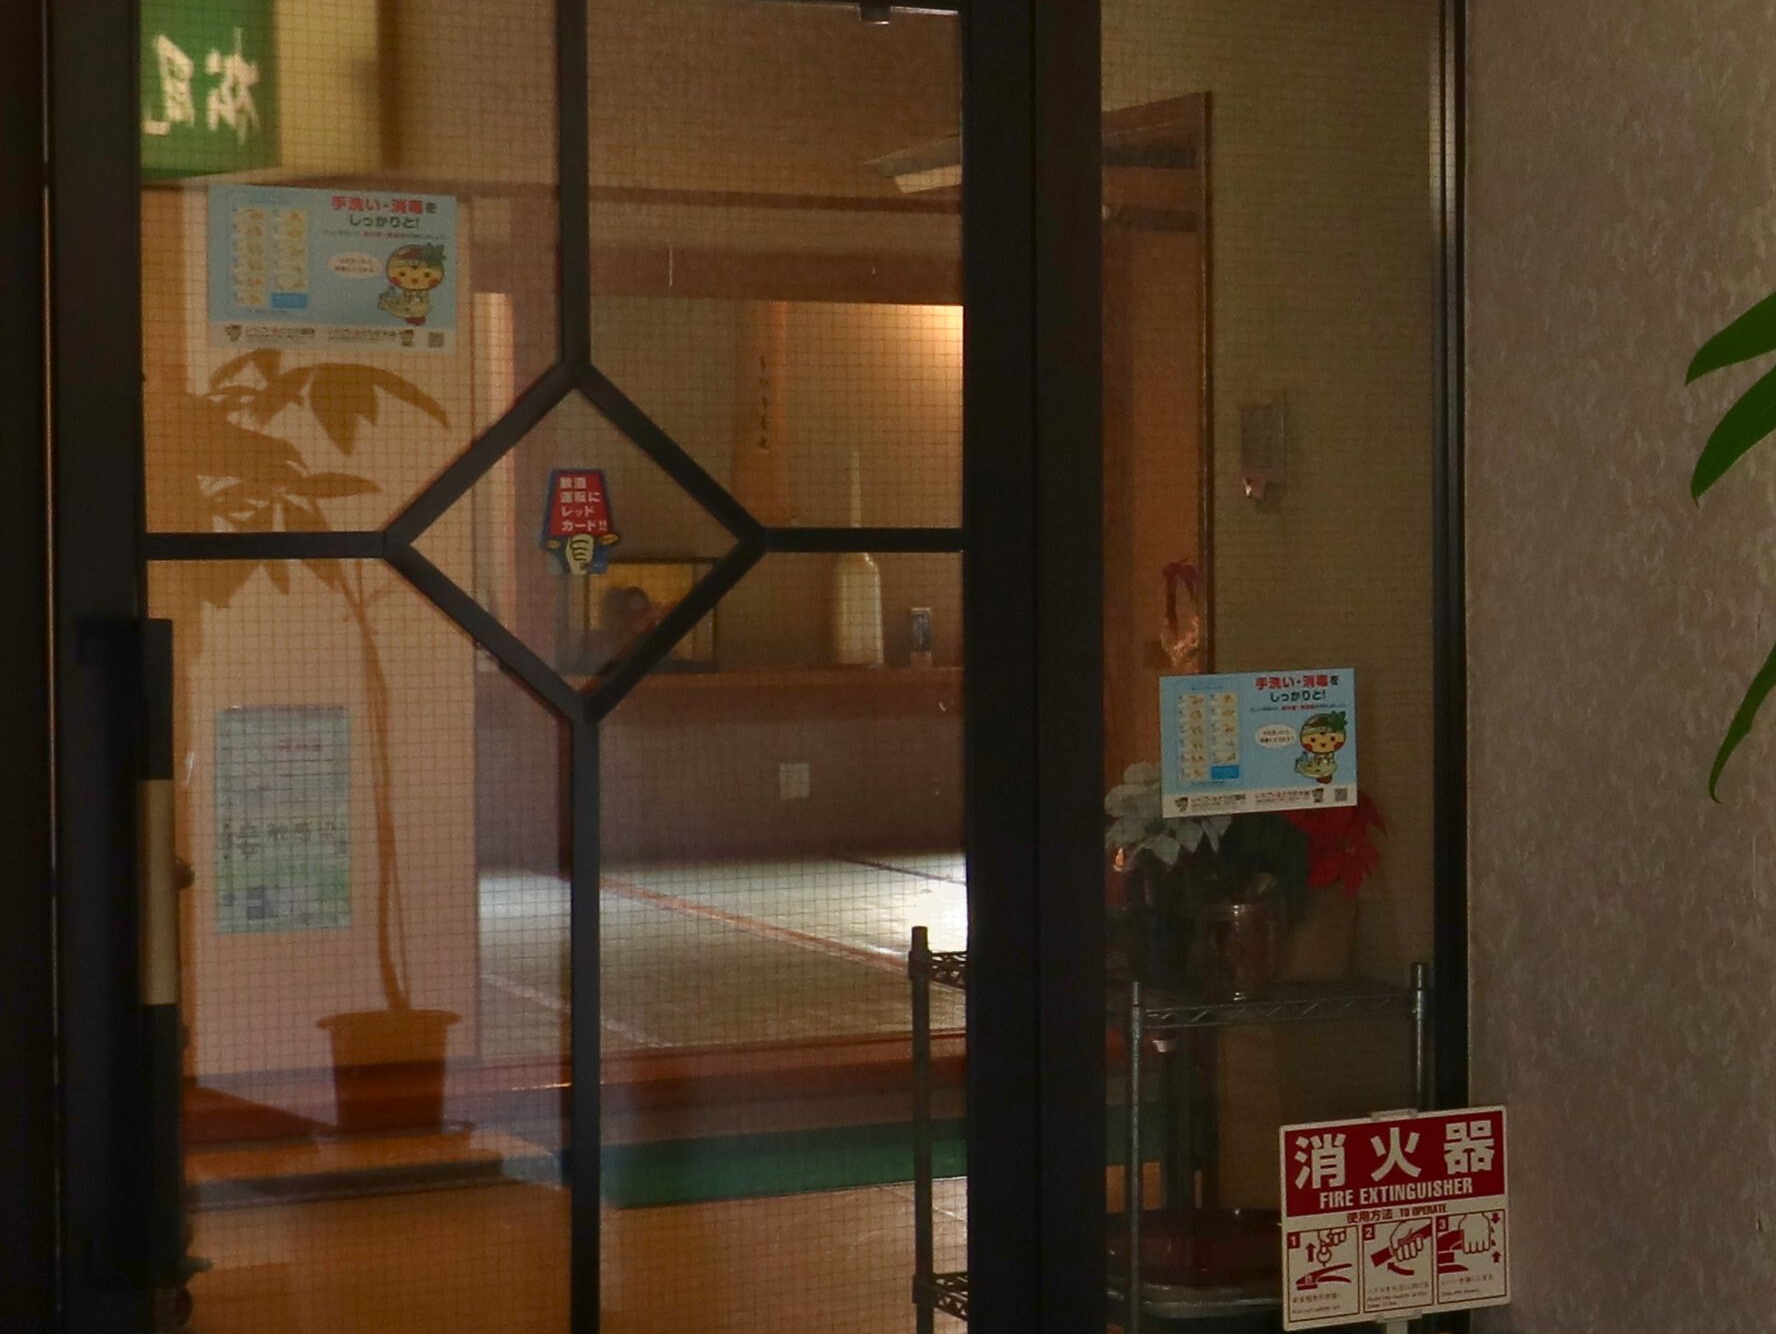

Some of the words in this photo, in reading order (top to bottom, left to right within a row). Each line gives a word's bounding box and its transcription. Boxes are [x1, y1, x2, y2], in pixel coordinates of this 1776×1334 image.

[1294, 1119, 1496, 1189] 消火器
[1320, 1189, 1354, 1209] FIRE
[1360, 1177, 1473, 1205] EXTINGUISHER
[1400, 1207, 1411, 1218] TO
[1412, 1204, 1447, 1217] OPERATE
[1438, 1217, 1447, 1230] 3
[1365, 1227, 1373, 1239] 2
